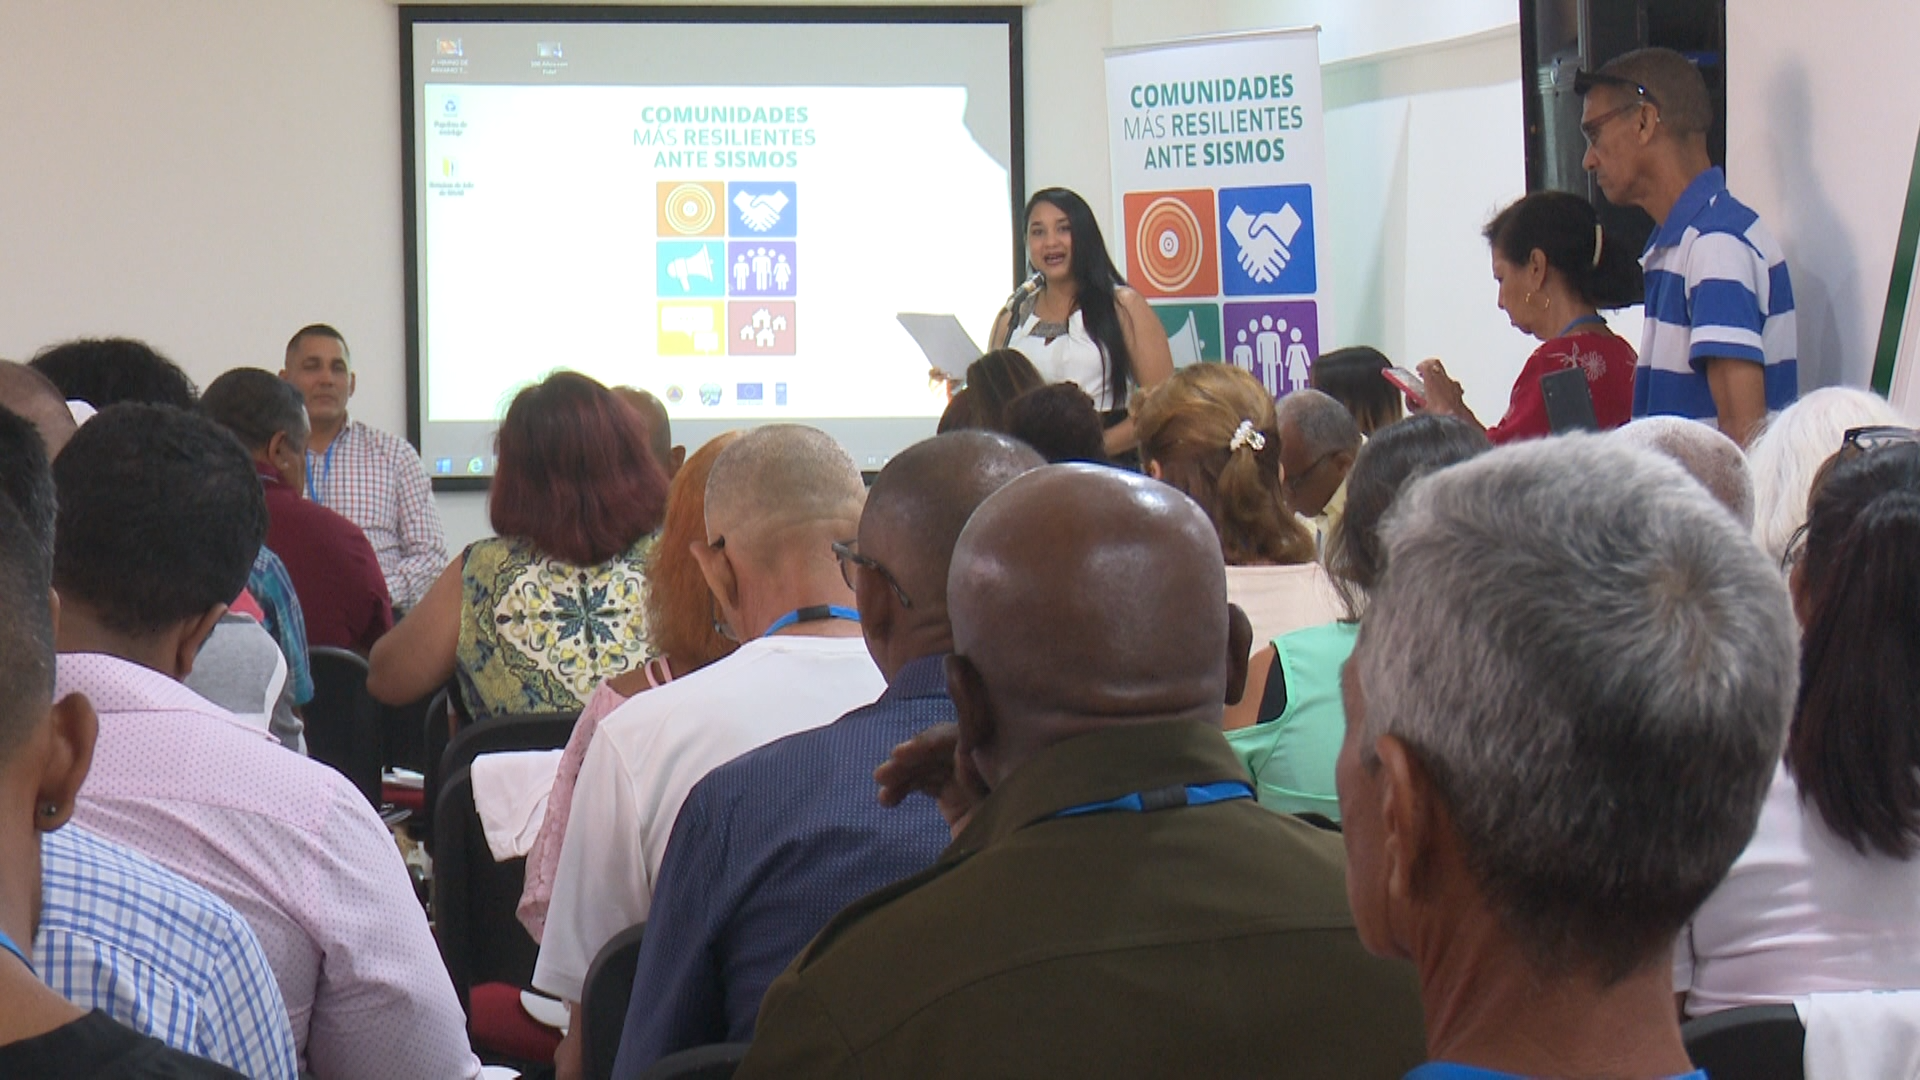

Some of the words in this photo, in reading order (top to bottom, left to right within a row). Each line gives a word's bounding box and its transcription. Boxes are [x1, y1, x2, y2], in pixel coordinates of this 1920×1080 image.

[1130, 73, 1294, 108] COMUNIDADES
[641, 106, 809, 124] COMUNIDADES
[1123, 109, 1166, 141] MÁS
[1171, 105, 1303, 137] RESILIENTES
[633, 123, 678, 146] MÁS
[684, 128, 816, 146] RESILIENTES
[654, 150, 708, 168] ANTE
[714, 150, 798, 168] SISMOS
[1144, 143, 1197, 170] ANTE
[1203, 137, 1285, 166] SISMOS
